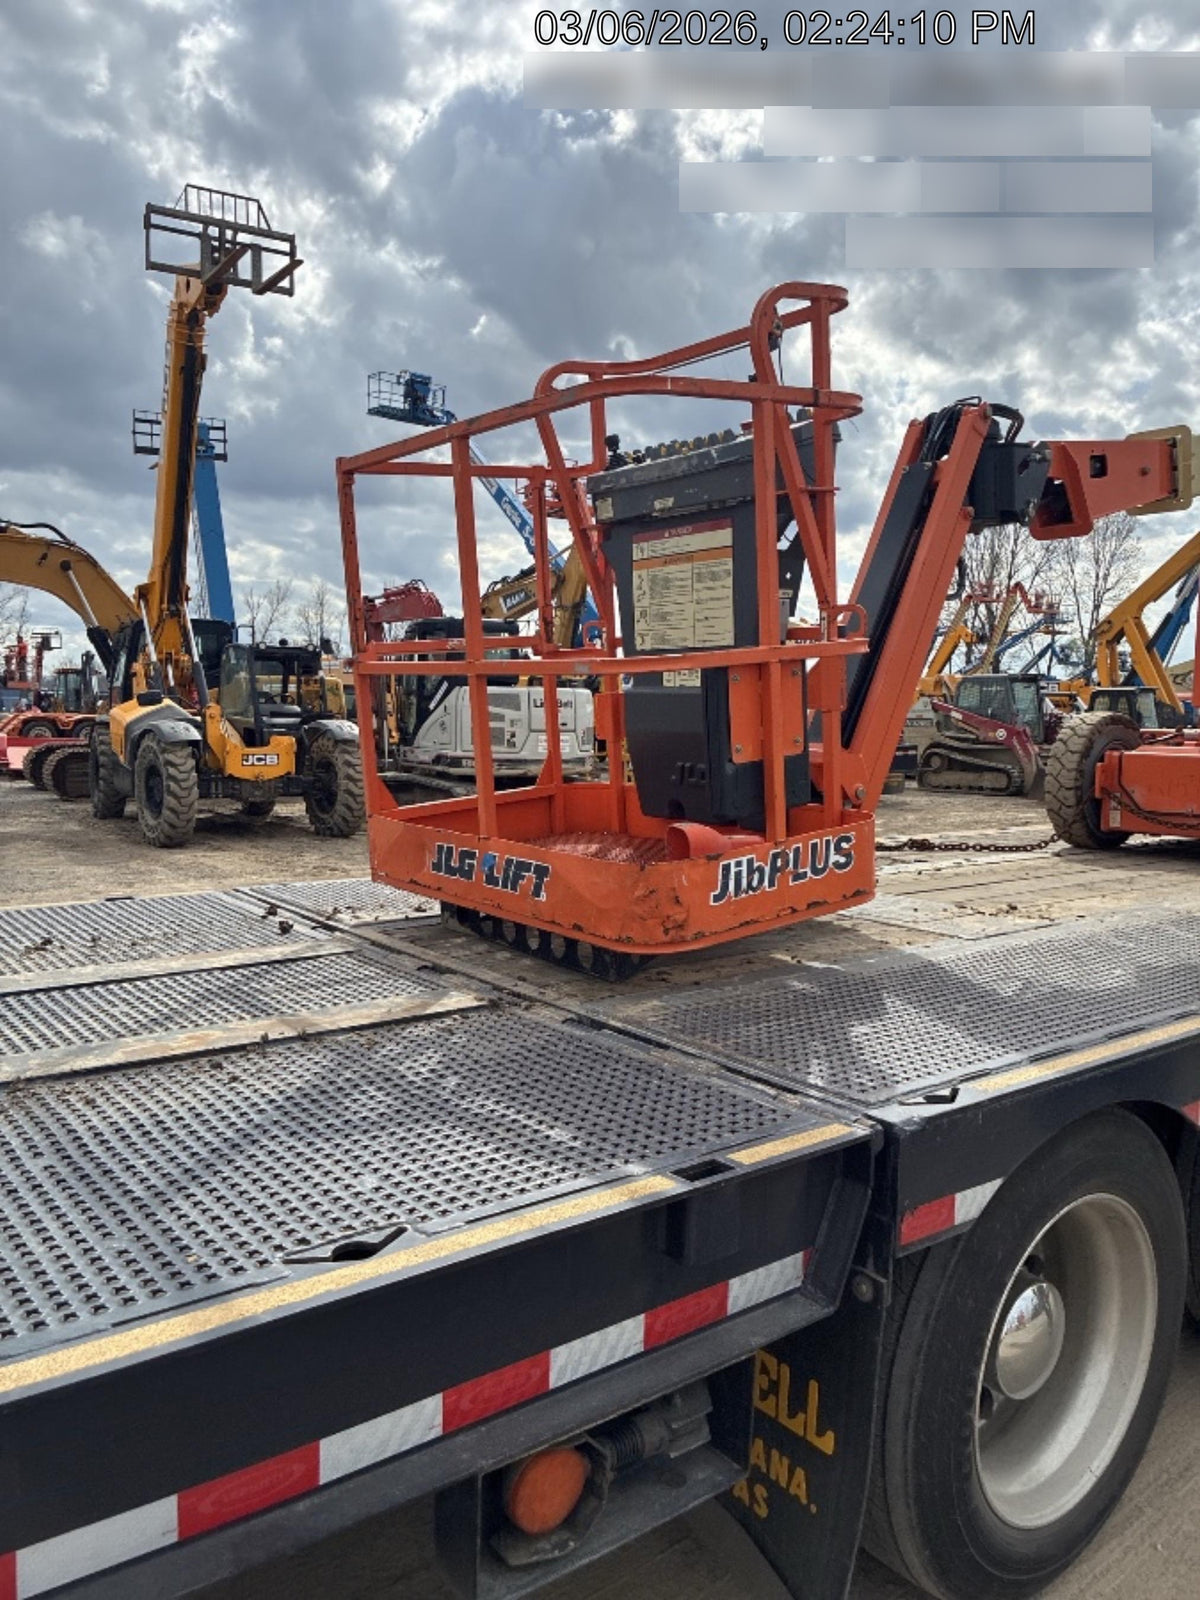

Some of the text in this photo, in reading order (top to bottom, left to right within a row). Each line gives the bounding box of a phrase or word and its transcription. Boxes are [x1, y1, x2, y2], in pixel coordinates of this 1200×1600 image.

[242, 754, 279, 766] JCB
[431, 842, 478, 881] JLG
[709, 831, 856, 906] JibPLUS
